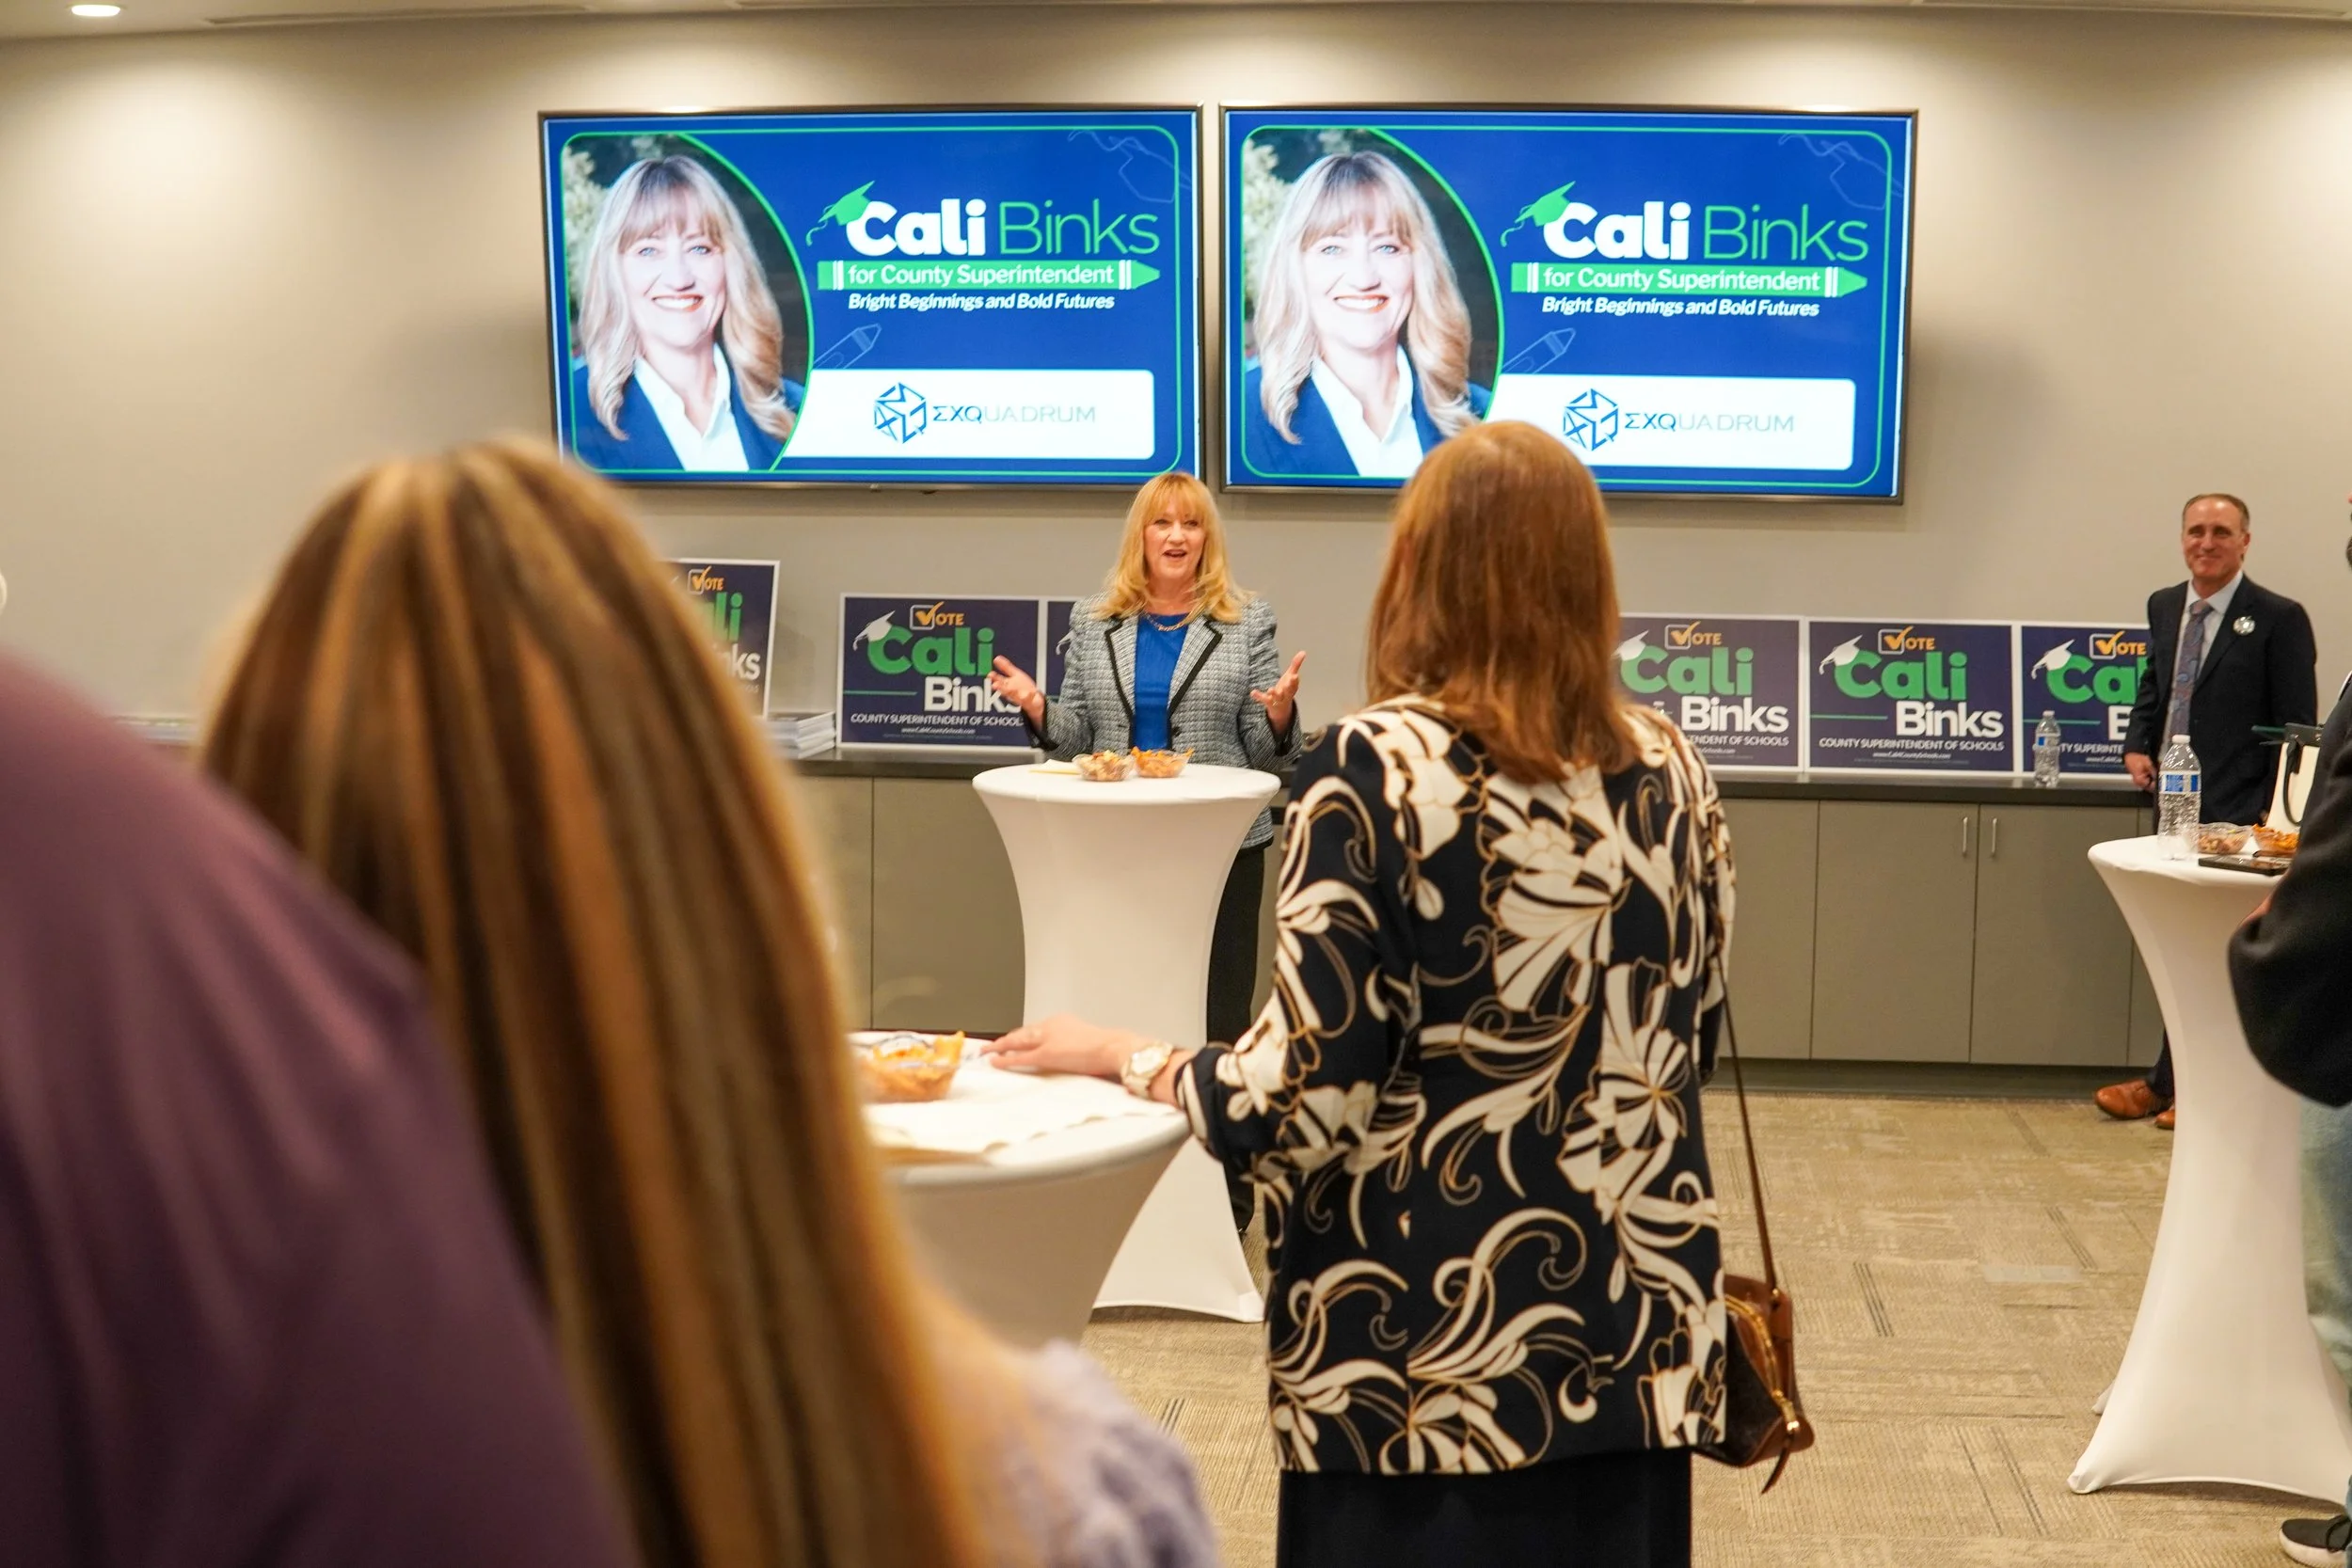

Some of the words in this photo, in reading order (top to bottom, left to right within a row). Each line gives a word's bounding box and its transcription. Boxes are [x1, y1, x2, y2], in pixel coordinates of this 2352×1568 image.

[847, 198, 987, 257] Cali
[999, 198, 1160, 254] Binks
[1543, 200, 1692, 261] Cali
[1704, 204, 1868, 262] Binks
[849, 264, 875, 284] for
[881, 264, 953, 287] County
[957, 264, 1114, 287] Superintendent
[1543, 267, 1574, 288] for
[1578, 267, 1654, 292] County
[1658, 268, 1820, 293] Superintendent
[849, 293, 897, 311] Bright
[898, 293, 984, 312] Beginnings
[985, 293, 1016, 309] and
[1017, 293, 1053, 309] Bold
[1055, 293, 1115, 309] Futures
[1542, 296, 1593, 316] Bright
[1595, 297, 1684, 317] Beginnings
[1685, 298, 1717, 315] and
[1718, 299, 1757, 316] Bold
[1758, 300, 1820, 316] Futures
[691, 566, 724, 591] VOTE
[915, 601, 964, 626] VOTE
[1670, 622, 1722, 647] VOTE
[1883, 626, 1935, 652] VOTE
[2095, 630, 2147, 656] VOTE
[867, 627, 994, 676] Cali
[1619, 646, 1755, 696] Cali
[1834, 651, 1968, 701] Cali
[2046, 654, 2149, 705] Ca
[850, 713, 889, 724] COUNTY
[890, 714, 968, 725] SUPERINTENDENT
[969, 716, 982, 726] OF
[1681, 696, 1789, 734] Binks
[1896, 701, 2004, 738] Binks
[1729, 736, 1743, 746] OF
[1744, 736, 1789, 746] SCHOOLS
[1819, 737, 1859, 749] COUNTY
[1860, 738, 1944, 750] SUPERINTENDENT
[1944, 740, 1958, 751] OF
[1959, 740, 2005, 752] SCHOOLS
